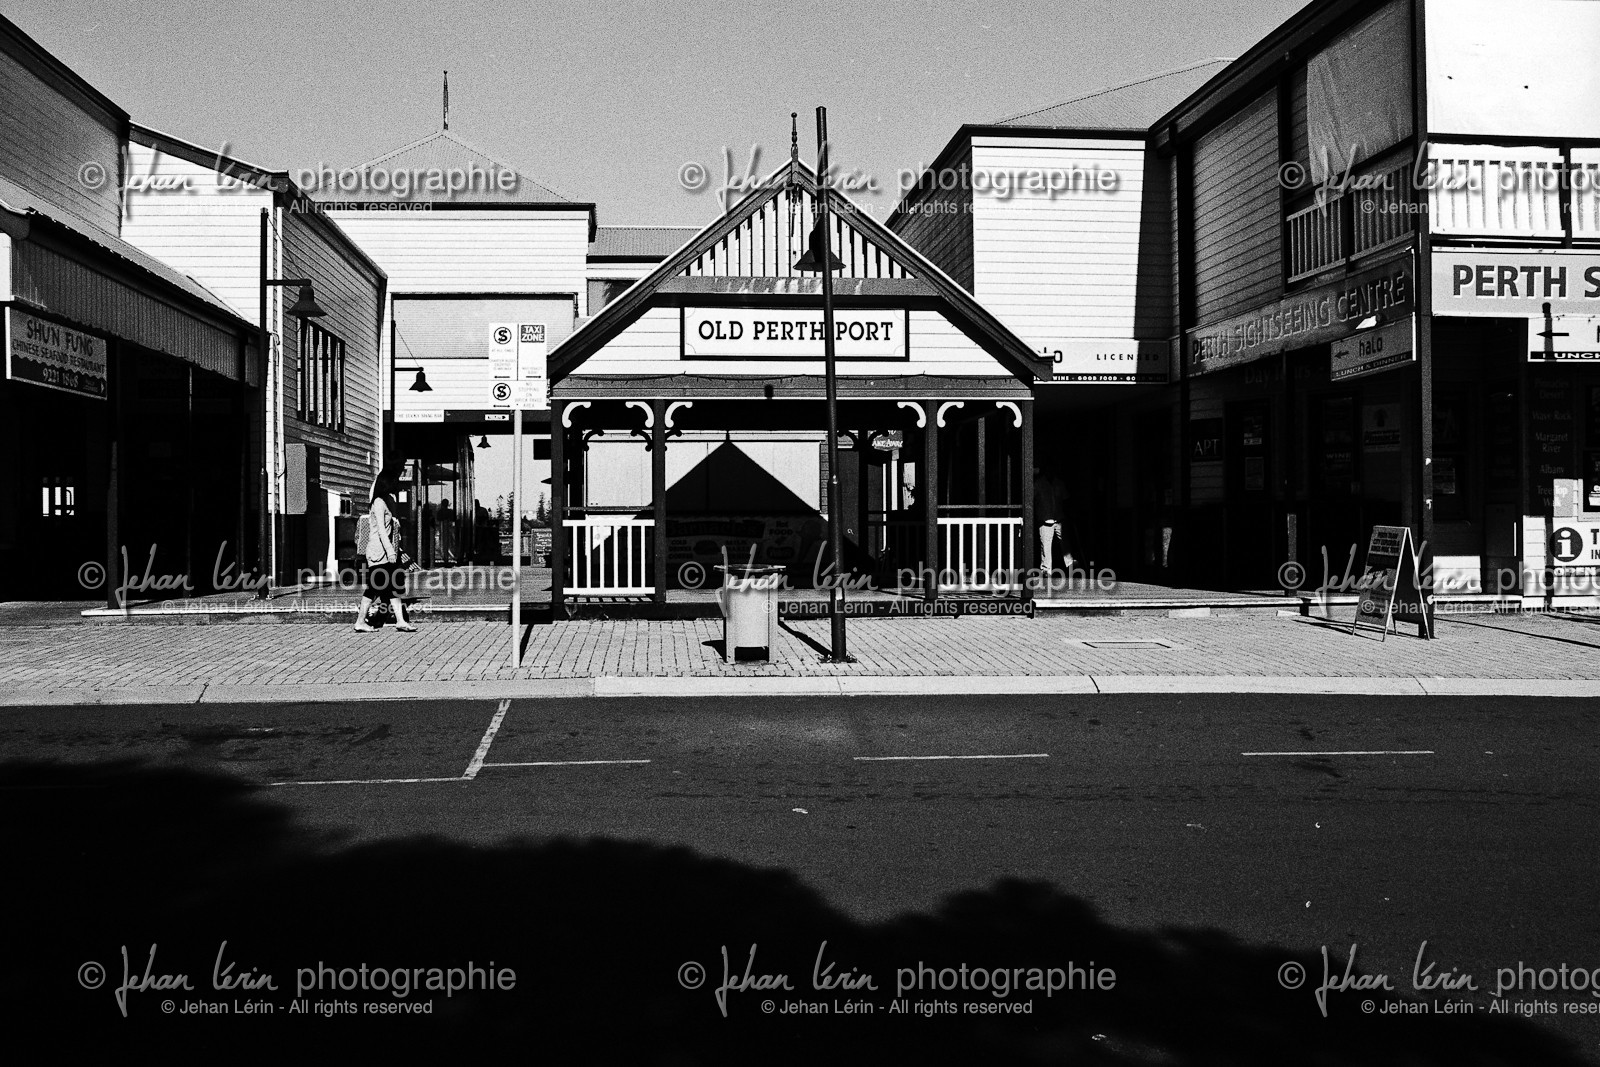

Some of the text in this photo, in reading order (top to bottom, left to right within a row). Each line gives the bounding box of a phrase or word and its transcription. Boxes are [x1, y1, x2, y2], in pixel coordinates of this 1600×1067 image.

[1453, 265, 1567, 297] PERTH
[1192, 271, 1406, 365] PERTH SIGHTSEEING CENTRE
[27, 320, 93, 357] SHUN FUNG
[521, 334, 544, 342] ZONE
[524, 326, 542, 334] TAXI
[698, 320, 893, 341] OLD PERTH PORT
[1359, 336, 1383, 357] halo
[1336, 366, 1364, 377] LUNCH
[1372, 354, 1408, 367] DINNER
[1194, 438, 1221, 457] APT
[1535, 432, 1568, 445] Margaret
[1542, 444, 1561, 453] River
[1554, 566, 1597, 576] OPEN
